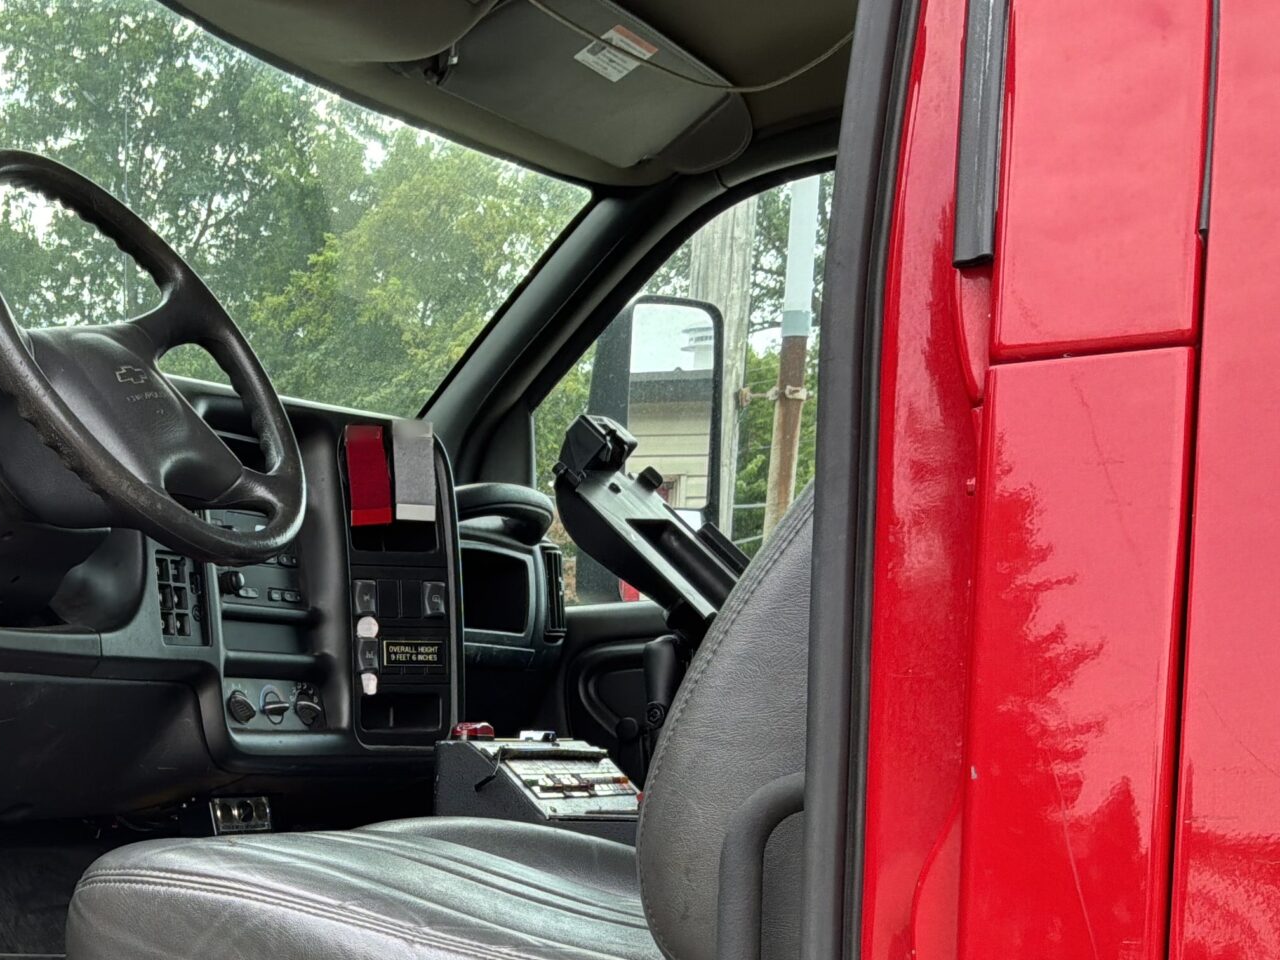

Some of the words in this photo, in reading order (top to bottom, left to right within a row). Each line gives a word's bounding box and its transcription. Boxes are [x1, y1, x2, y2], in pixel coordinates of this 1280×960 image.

[388, 645, 417, 653] OVERALL
[418, 645, 438, 654] HEIGHT
[396, 653, 410, 661] FEET
